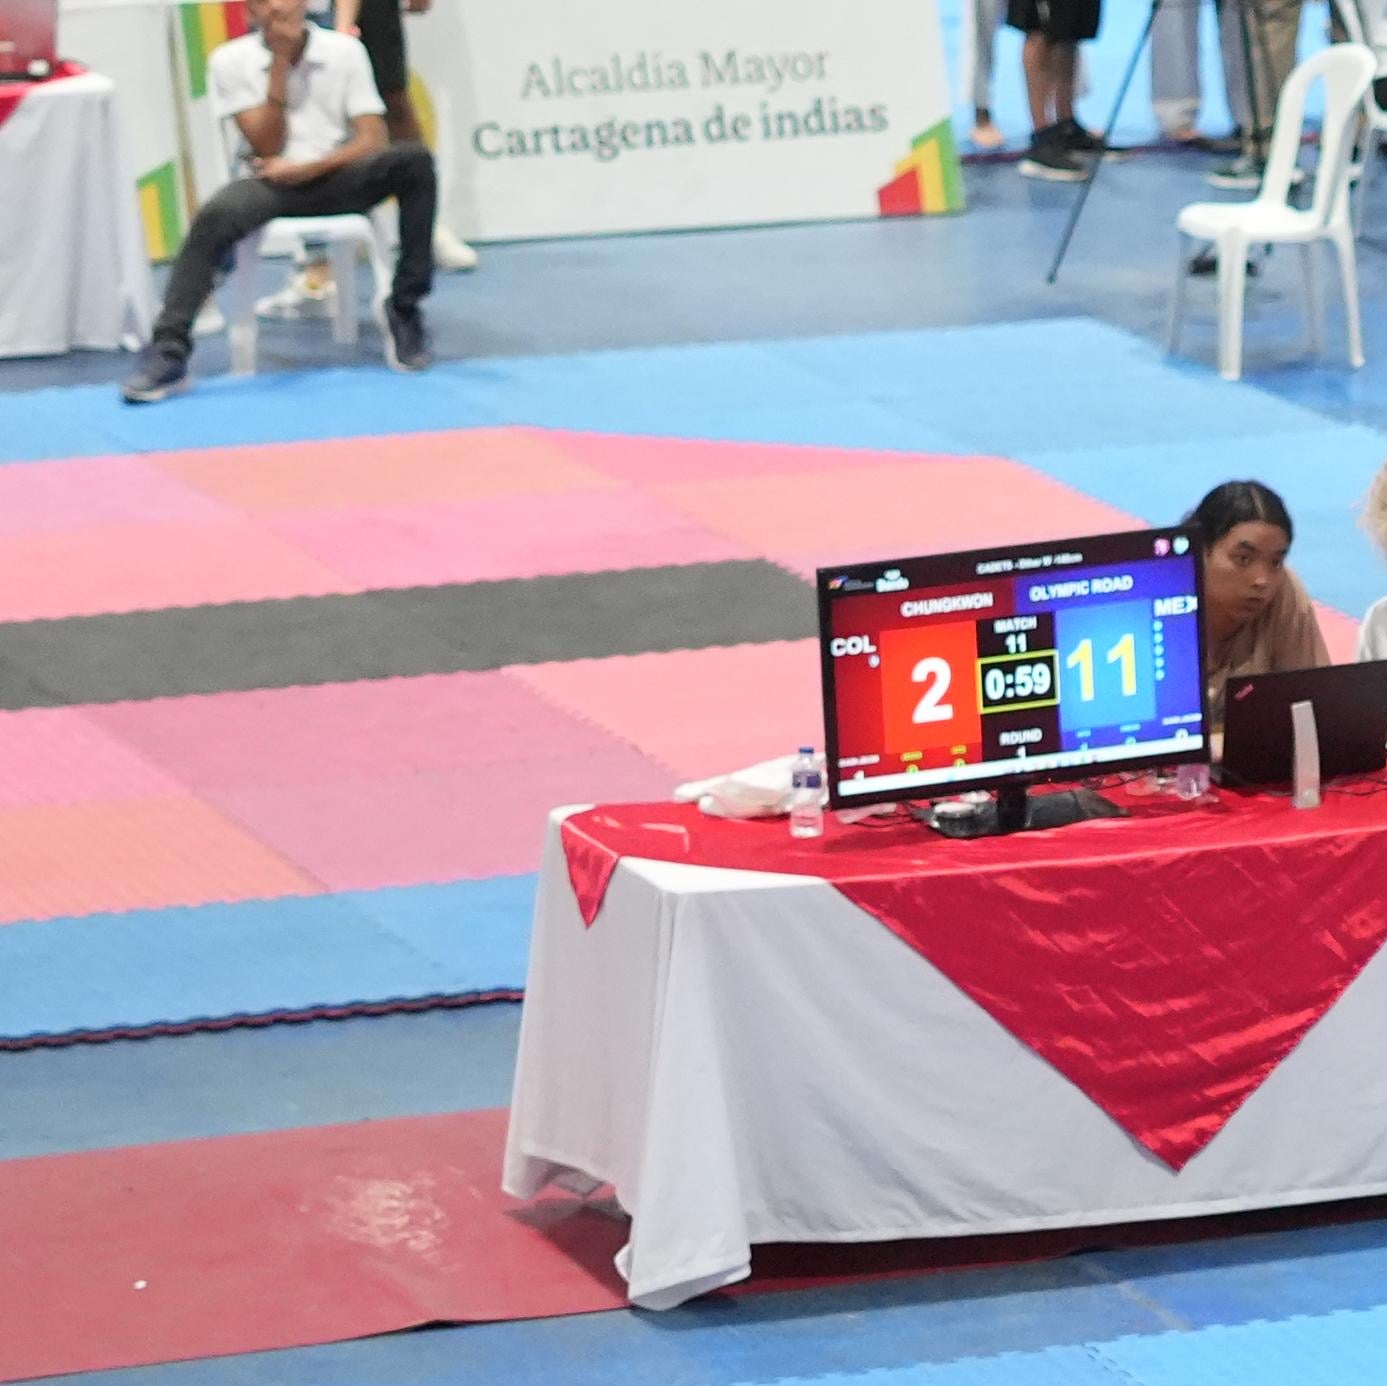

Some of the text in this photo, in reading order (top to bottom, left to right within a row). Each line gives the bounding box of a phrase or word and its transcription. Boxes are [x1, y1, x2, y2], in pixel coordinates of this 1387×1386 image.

[520, 48, 829, 100] Alcaldía Mayor
[472, 96, 889, 162] Cartagena de indias
[1029, 575, 1133, 602] OLYMPIC ROAD
[1154, 595, 1198, 616] MEX
[993, 616, 1037, 634] MATCH
[830, 635, 877, 657] COL
[1005, 633, 1027, 653] 11
[1066, 633, 1138, 702] 11
[911, 656, 953, 724] 2
[984, 663, 1050, 700] 0:59
[1000, 728, 1043, 745] ROUND
